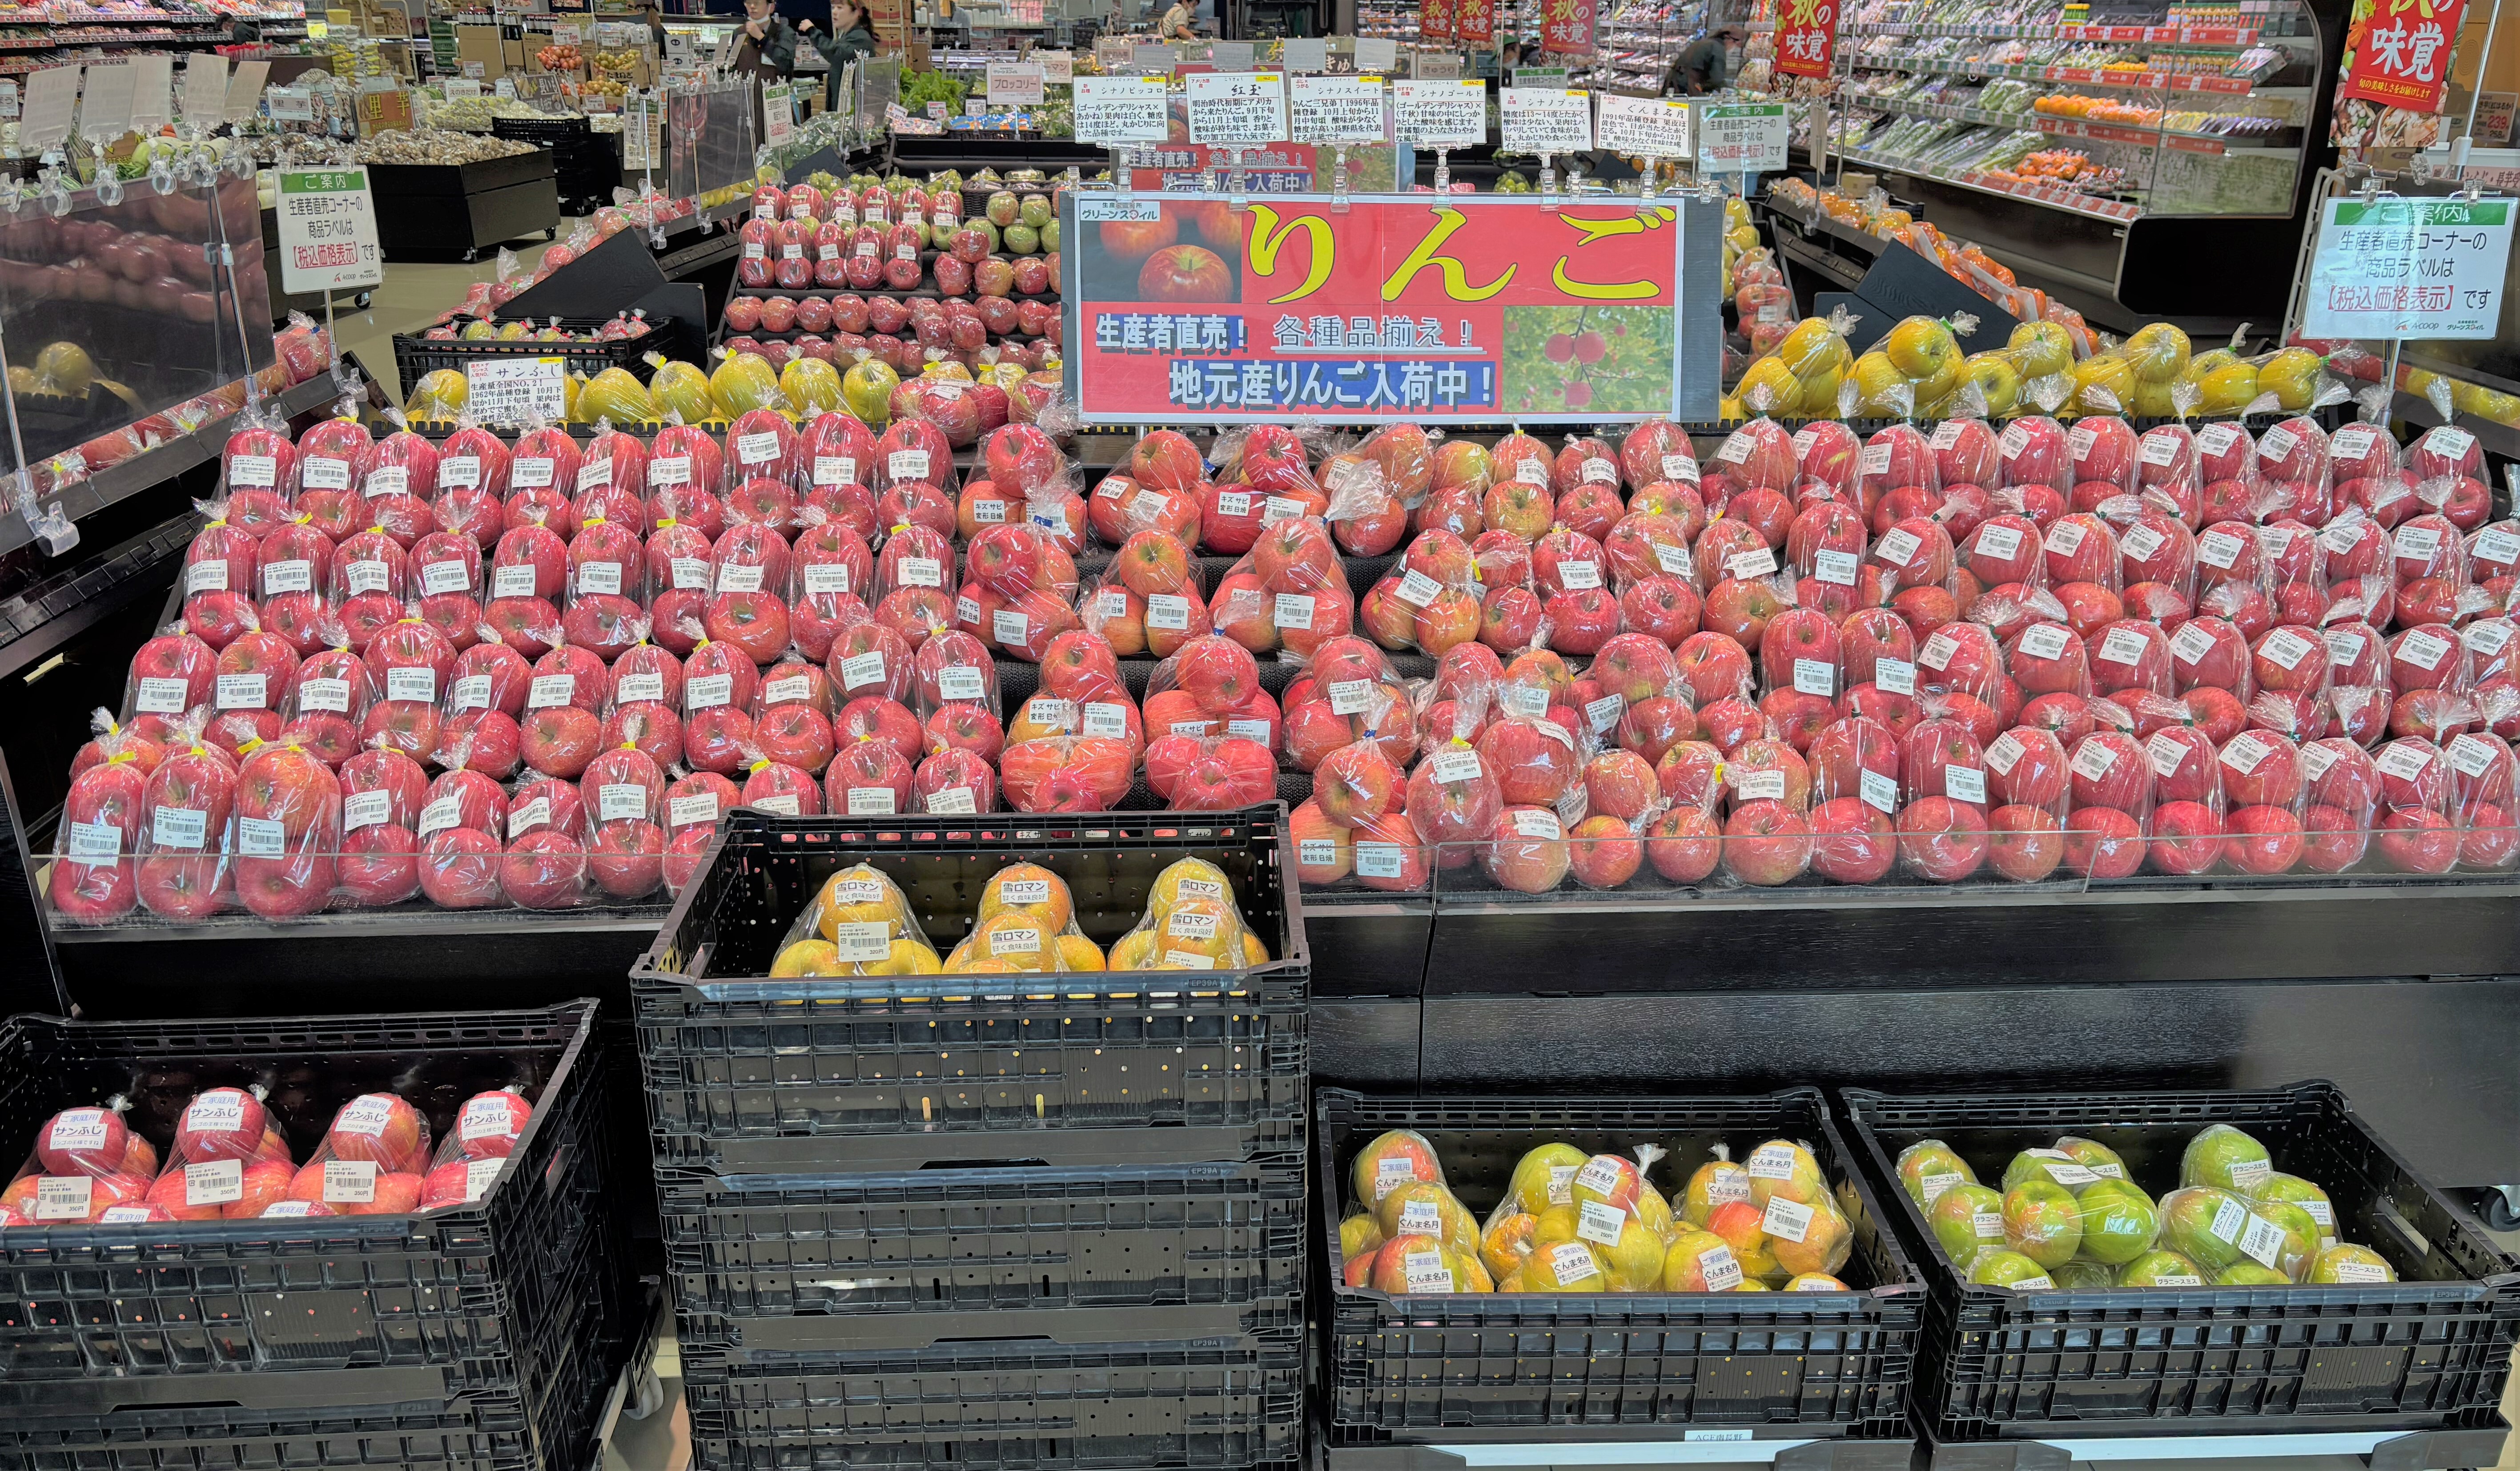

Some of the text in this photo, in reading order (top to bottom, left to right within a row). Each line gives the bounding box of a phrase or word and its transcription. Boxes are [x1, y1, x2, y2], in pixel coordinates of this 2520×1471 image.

[1547, 0, 1589, 22] 秋の
[1786, 0, 1831, 28] 秋の
[1425, 17, 1447, 32] 味覚
[1463, 17, 1488, 33] 味覚
[1550, 22, 1588, 44] 味覚
[1786, 28, 1827, 62] 味覚
[2370, 17, 2444, 82] 味覚
[994, 79, 1036, 89] ブロッコリー
[2359, 78, 2431, 98] 旬の美味しさをお届けします
[1231, 85, 1261, 96] 紅玉
[273, 99, 307, 109] 里芋
[369, 92, 410, 121] 里芋
[1193, 98, 1271, 107] 明治時代初期にアメリカ
[1193, 106, 1274, 116] から来たりんご。9月下旬
[1628, 105, 1683, 118] ぐんま名月
[1727, 107, 1764, 115] ご案内
[1332, 116, 1376, 124] 酸味が少なく
[1710, 119, 1776, 130] 生産者直売コーナーの
[1194, 124, 1277, 133] 酸味が持ち味で、お菓子
[1723, 132, 1763, 142] 商品ラベルは
[1768, 146, 1781, 156] です
[305, 174, 346, 189] ご案内
[289, 196, 362, 215] 生産者直売コーナーの
[2381, 204, 2464, 224] ご案内
[308, 218, 354, 238] 商品ラベルは
[2339, 230, 2487, 251] 生産者直売コーナーの
[293, 242, 374, 269] 【税込価格表示】 です
[1247, 205, 1677, 304] りんご
[2366, 258, 2455, 278] 商品ラベルは
[2328, 285, 2492, 311] 【税込価格表示】 です
[1096, 314, 1473, 350] 生産者直売！ 各種品揃え！
[496, 363, 559, 378] サンふじ
[1169, 362, 1492, 406] 地元産りんご入荷中！
[1220, 496, 1248, 504] キズ サビ
[975, 503, 990, 511] キズ
[1220, 504, 1234, 512] 変形
[975, 512, 1004, 521] 変形 日焼
[837, 882, 879, 891] 雪ロマン
[1003, 882, 1045, 892] 雪ロマン
[1180, 879, 1219, 892] 雪ロマン
[836, 893, 880, 901] 甘く食味良好
[1002, 893, 1046, 902] 甘く食味良好
[1172, 914, 1214, 925] 雪ロマン
[992, 930, 1036, 942] 雪ロマン
[1170, 927, 1213, 935] 甘く食味良好
[992, 943, 1037, 951] 甘く食味良好
[199, 1096, 237, 1105] ご家庭用
[353, 1099, 388, 1110] ご家庭用
[469, 1102, 503, 1112] ご家庭用
[60, 1114, 99, 1123] ご家庭用
[191, 1108, 237, 1118] サンふじ
[345, 1111, 384, 1123] サンふじ
[463, 1112, 507, 1127] サンふじ
[55, 1126, 102, 1136] サンふじ
[1760, 1150, 1791, 1158] ご家庭用
[1380, 1163, 1411, 1172] ご家庭用
[1592, 1159, 1617, 1172] ご家庭用
[1752, 1158, 1791, 1168] ぐんま名月
[2233, 1163, 2267, 1173] グラニースミス
[1582, 1167, 1615, 1185] ぐんま名月
[1716, 1175, 1748, 1184] ご家庭用
[1709, 1185, 1748, 1197] ぐんま名月
[1406, 1206, 1435, 1216] ご家庭用
[106, 1211, 145, 1223] ご家庭用
[2213, 1201, 2233, 1233] グラニースミス
[1399, 1218, 1438, 1229] ぐんま名月
[1407, 1257, 1439, 1266] ご家庭用
[1703, 1251, 1728, 1267] ご家庭用
[1554, 1257, 1591, 1273] ぐんま名月
[1704, 1263, 1738, 1278] ぐんま名月
[2340, 1265, 2383, 1274] グラニースミス
[1407, 1272, 1449, 1283] ぐんま名月
[2014, 1279, 2048, 1290] グラニースミス
